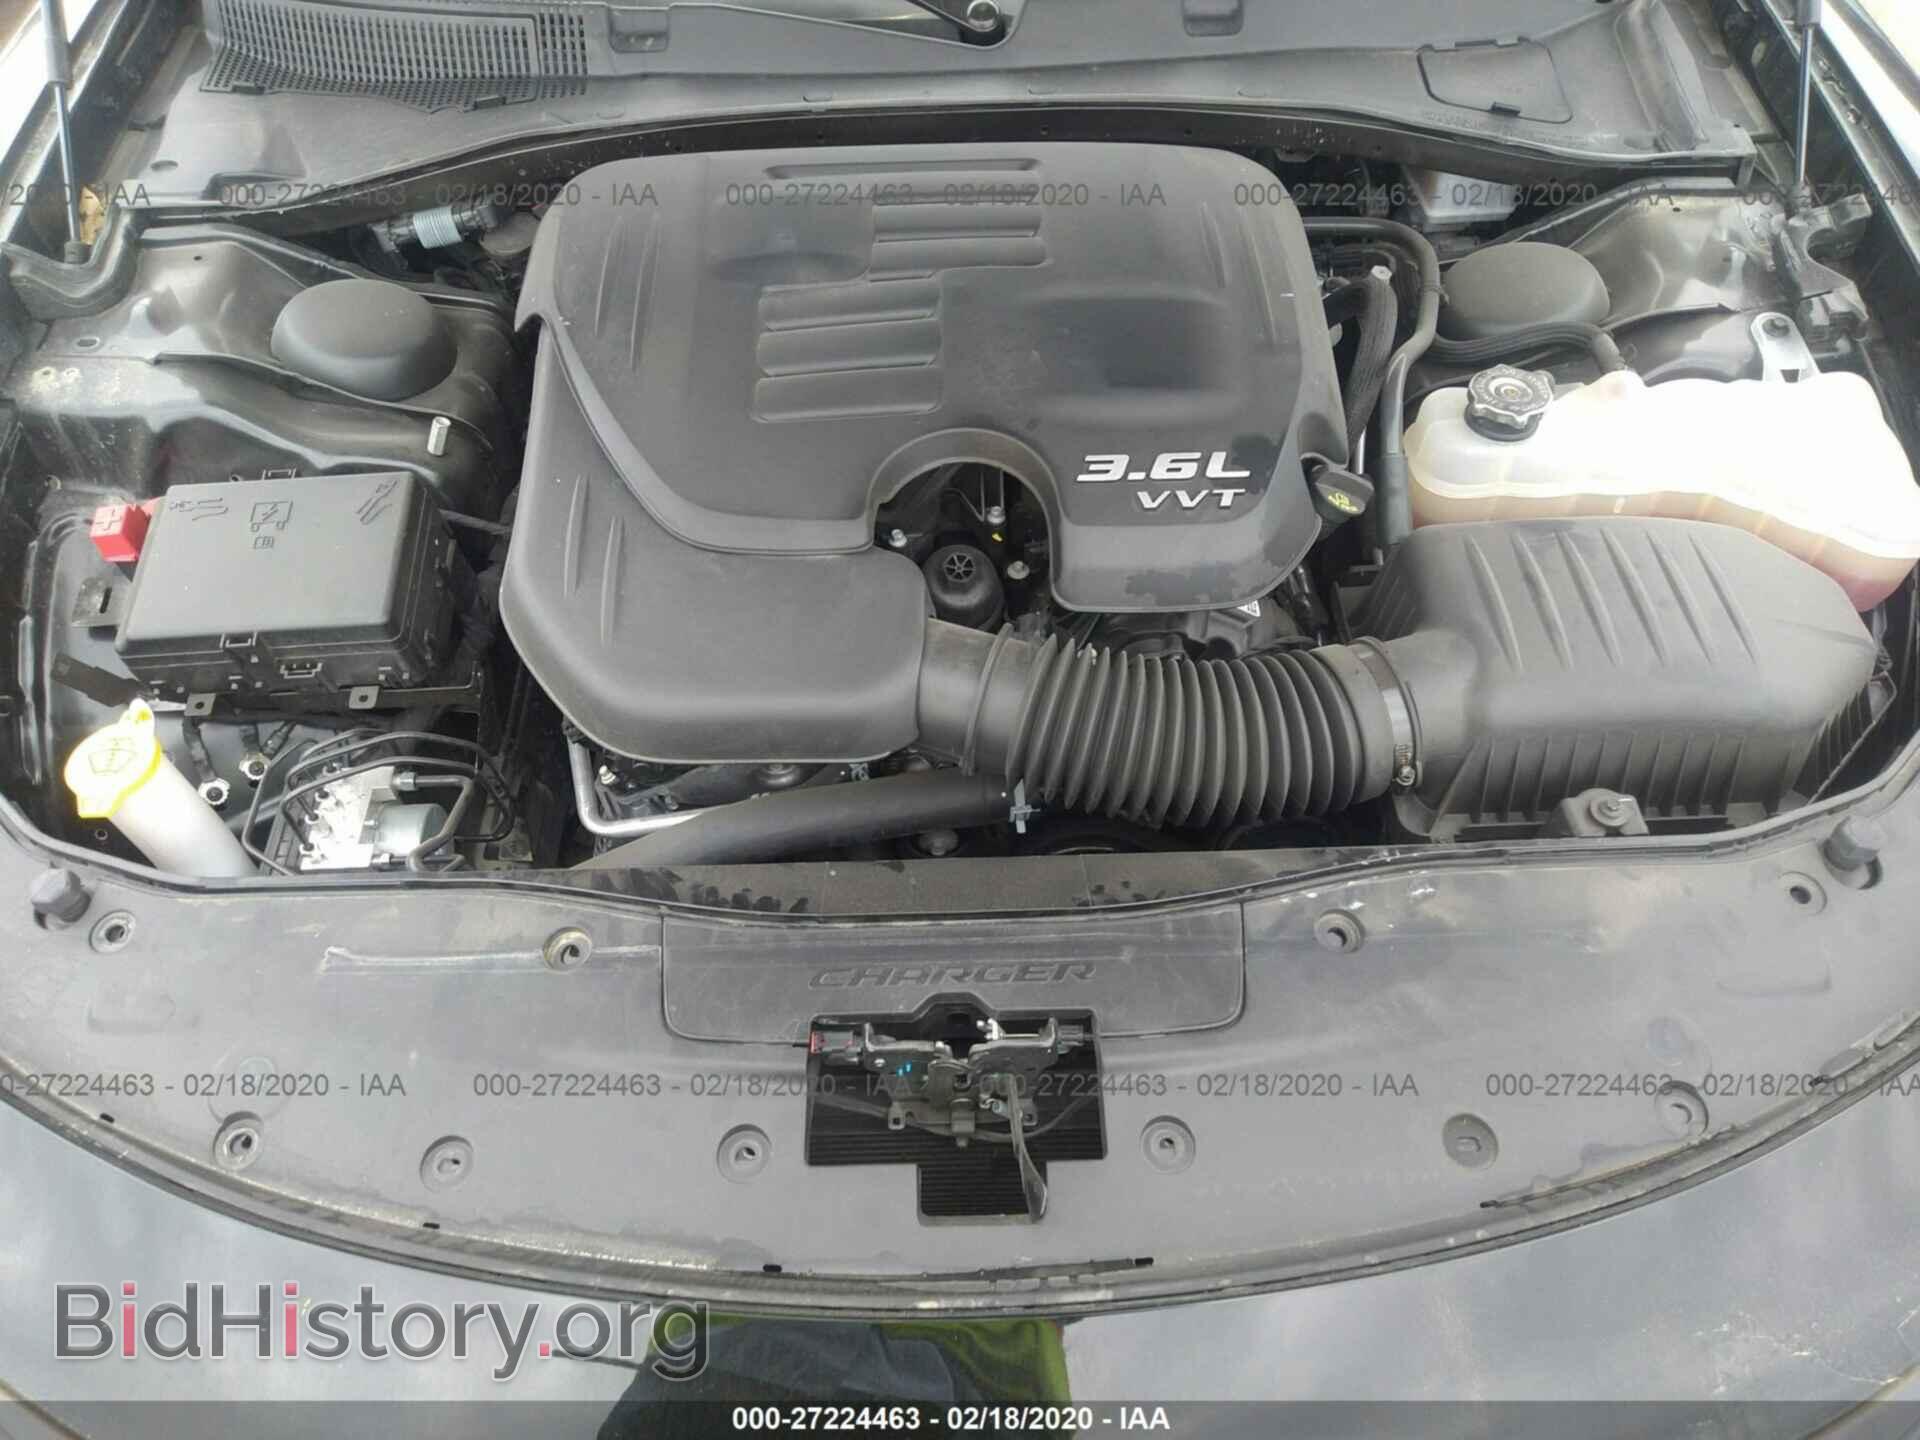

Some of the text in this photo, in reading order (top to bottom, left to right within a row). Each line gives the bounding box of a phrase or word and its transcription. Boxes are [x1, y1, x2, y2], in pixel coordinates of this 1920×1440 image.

[1077, 451, 1251, 482] 3.6L
[1137, 488, 1246, 509] VVT
[808, 961, 1096, 989] CHARGER
